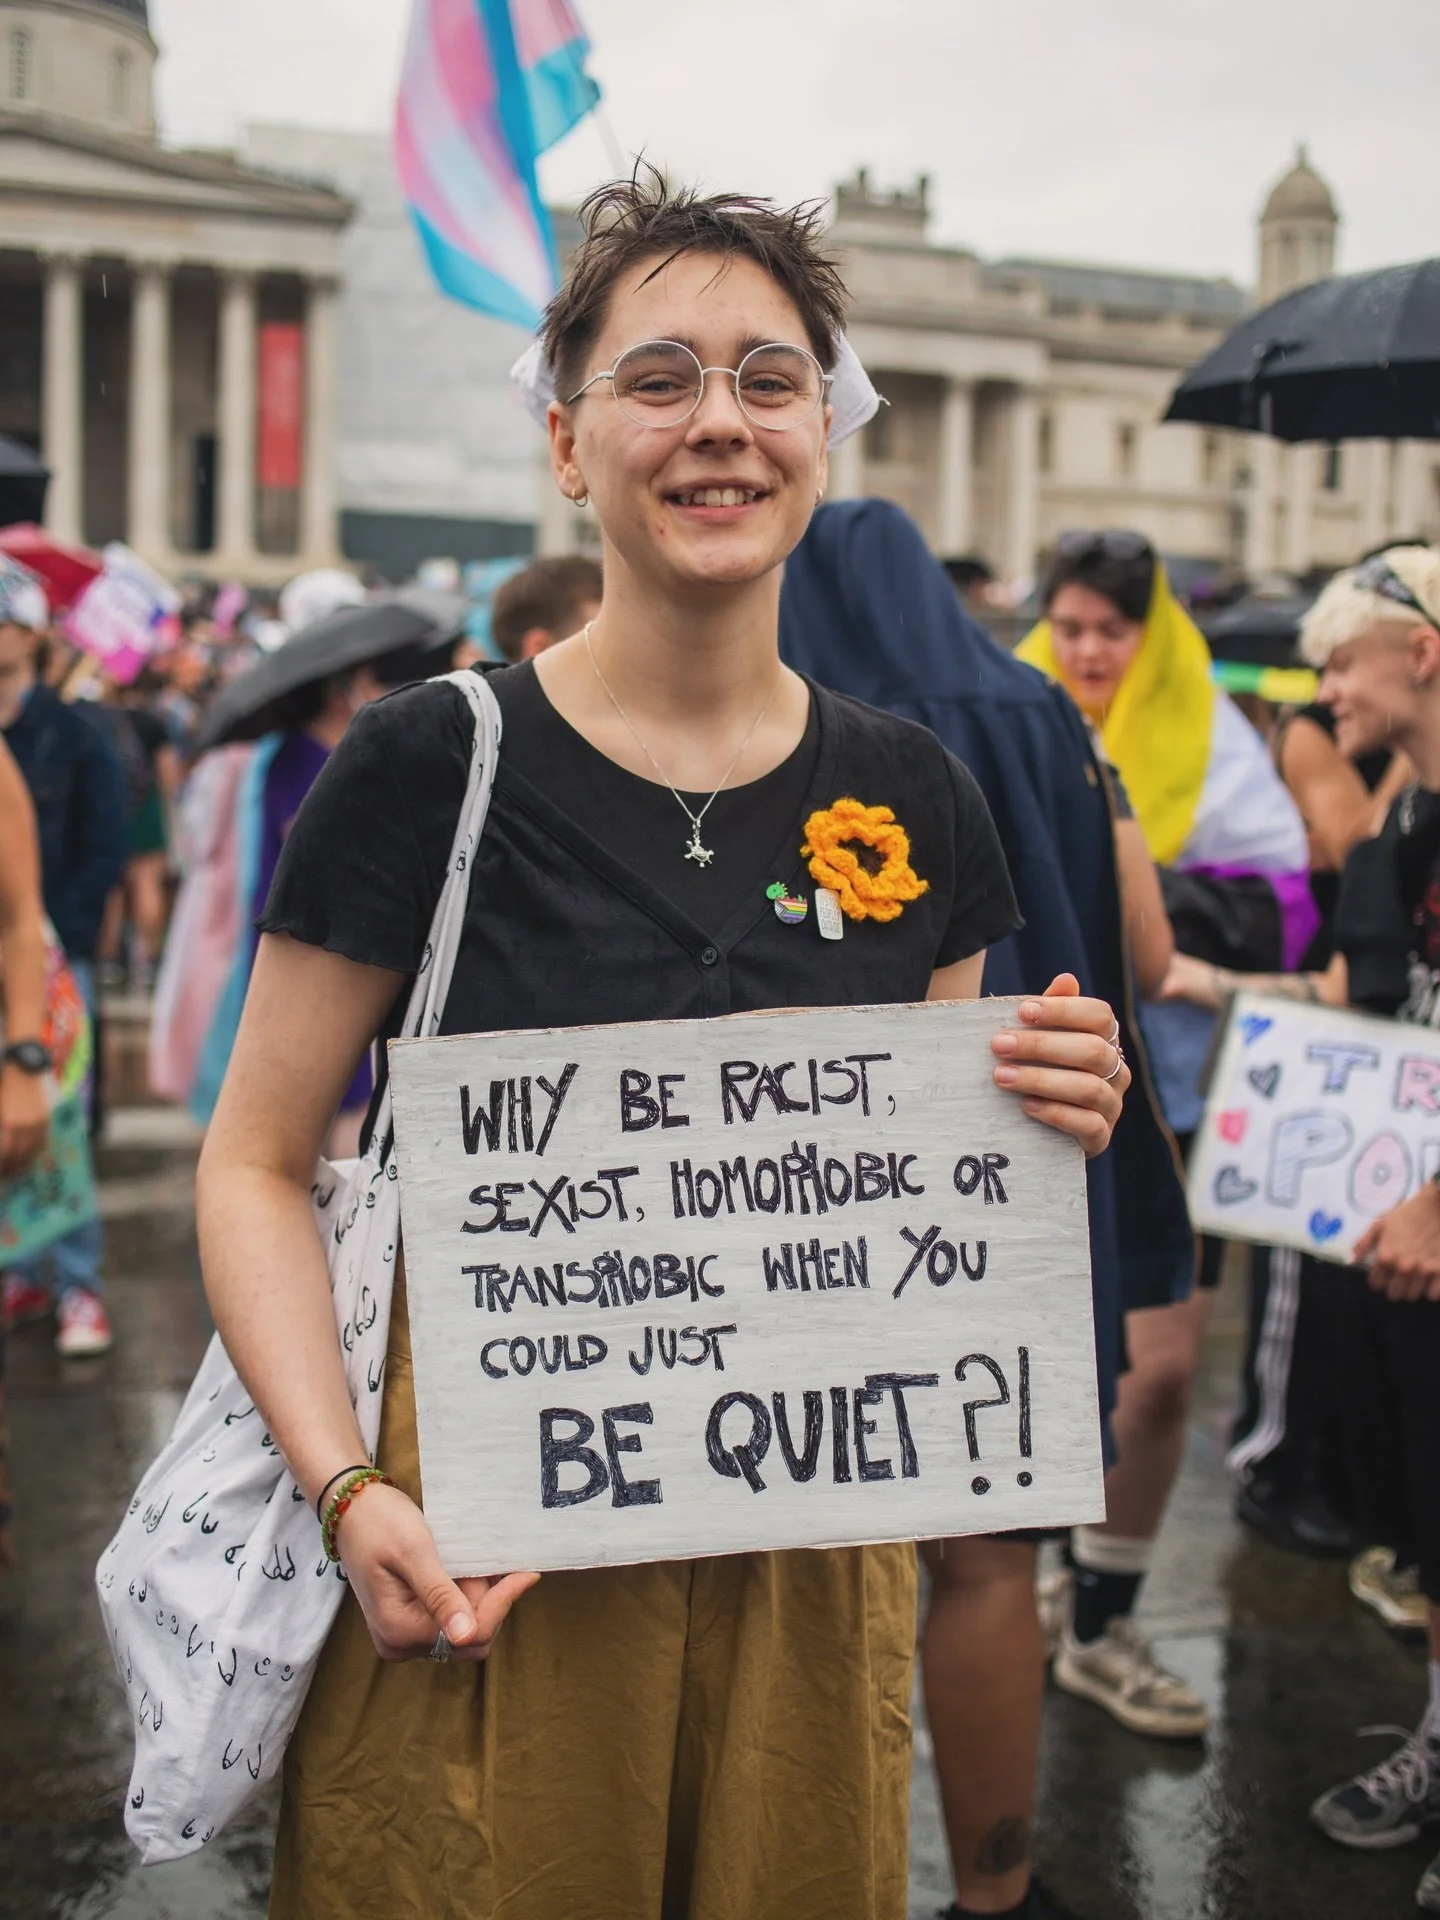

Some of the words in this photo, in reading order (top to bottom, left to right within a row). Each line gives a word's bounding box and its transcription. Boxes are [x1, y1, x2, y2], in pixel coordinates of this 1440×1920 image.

[459, 1063, 579, 1157] WHY
[620, 1068, 690, 1132] BE
[720, 1053, 896, 1117] RACIST,
[460, 1165, 645, 1238] SEXIST,
[669, 1140, 925, 1219] HOMOPHOBIC
[953, 1153, 1010, 1205] OR
[461, 1250, 726, 1313] TRANSPHOBIC
[763, 1236, 870, 1293] WHEN
[892, 1225, 987, 1299] YOU
[480, 1334, 608, 1379] COULD
[629, 1323, 737, 1376] JUST
[539, 1402, 663, 1509] BE
